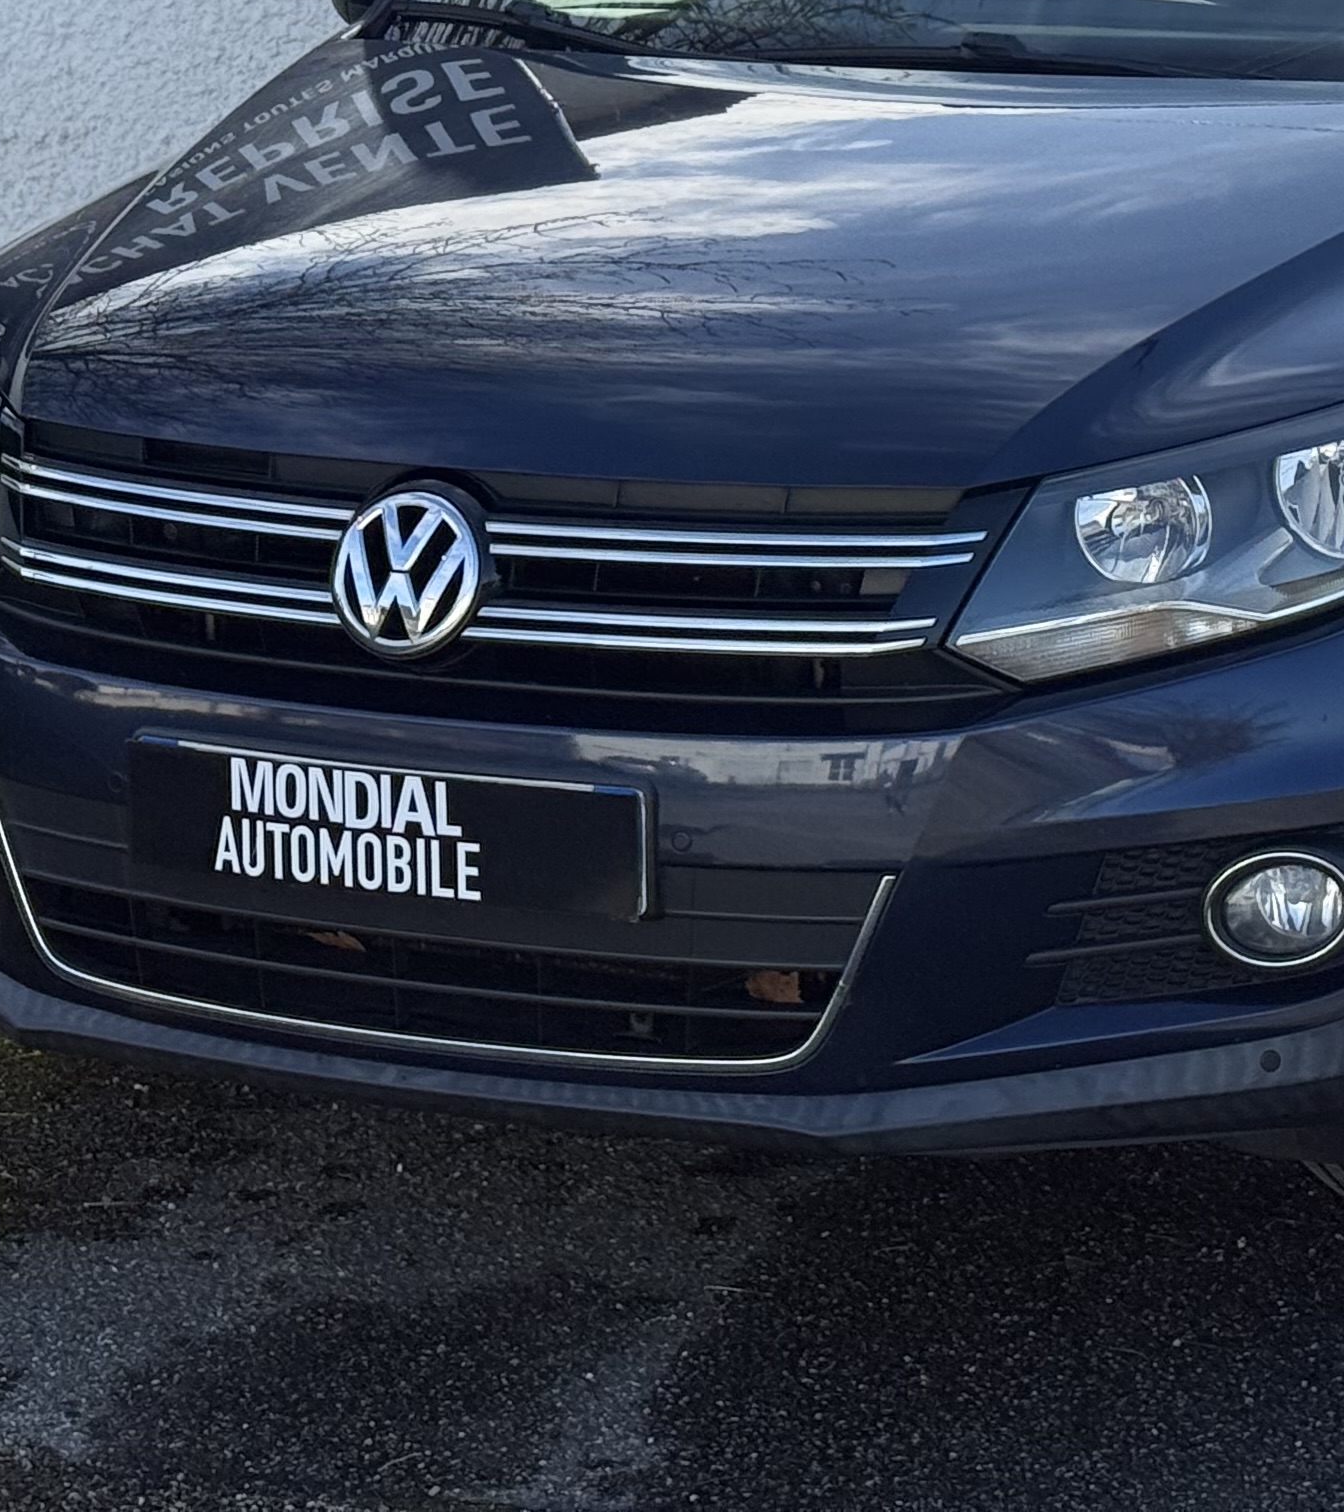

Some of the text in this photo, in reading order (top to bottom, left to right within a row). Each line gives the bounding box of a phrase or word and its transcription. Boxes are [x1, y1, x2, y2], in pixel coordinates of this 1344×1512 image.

[336, 494, 477, 652] VW
[229, 756, 463, 837] MONDIAL
[213, 814, 482, 902] AUTOMOBILE
